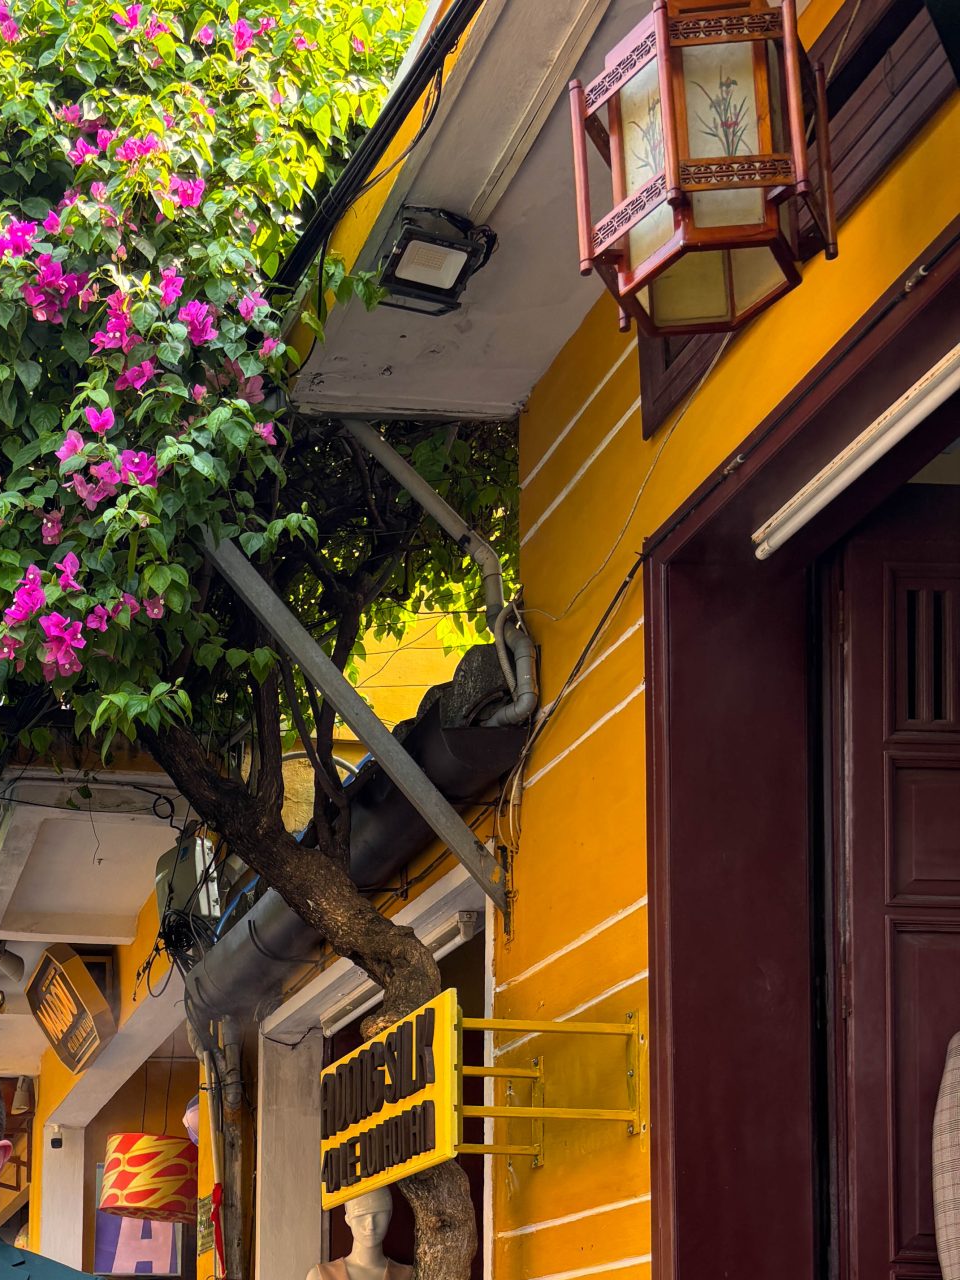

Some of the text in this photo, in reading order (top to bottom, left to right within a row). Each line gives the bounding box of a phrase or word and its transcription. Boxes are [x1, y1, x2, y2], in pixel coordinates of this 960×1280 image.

[37, 975, 78, 1044] MAROU
[321, 1073, 336, 1140] A
[384, 1008, 435, 1104] SILK
[410, 1100, 435, 1156] AN
